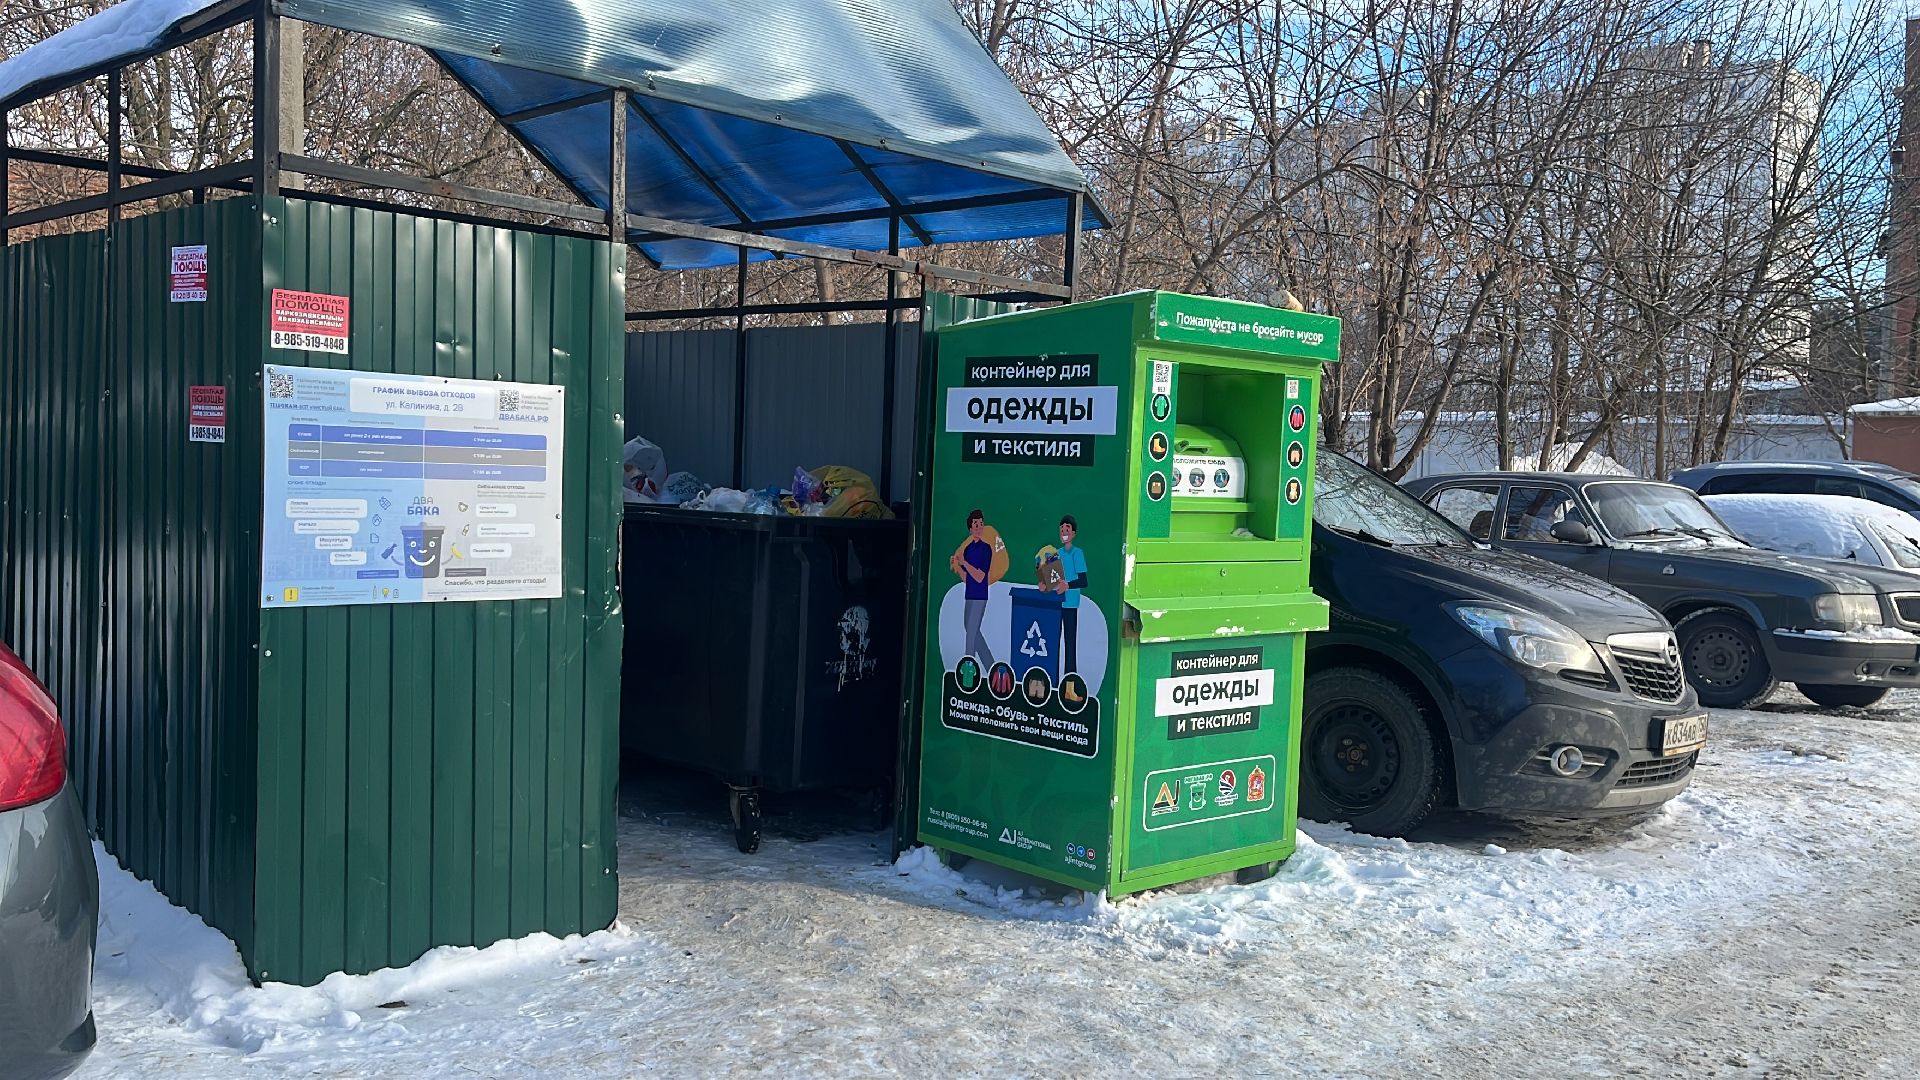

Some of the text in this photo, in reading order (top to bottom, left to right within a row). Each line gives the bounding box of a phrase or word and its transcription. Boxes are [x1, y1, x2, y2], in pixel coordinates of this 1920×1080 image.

[275, 300, 344, 314] ПОМОЩЬ
[276, 292, 344, 305] БЕСПЛАТНАЯ
[1176, 312, 1324, 344] Пожалуйста не бросайте мусор
[274, 332, 344, 350] 8-985-519-4848
[971, 362, 1091, 382] контейнер для
[372, 386, 476, 399] ГРАФИК ВЫВОЗА ОТХОДОВ
[385, 401, 397, 410] ул.
[399, 401, 442, 412] Калинина,
[967, 397, 1093, 424] одежды
[498, 414, 548, 422] ДВАБАКА.РФ
[974, 440, 1081, 457] и текстиля
[412, 496, 434, 506] ДВА
[408, 506, 440, 516] БАКА
[1176, 654, 1258, 669] контейнер для
[1172, 679, 1260, 706] одежды
[950, 709, 1088, 746] Можете положить свои вещи сюда
[996, 706, 1028, 722] Обувь
[1038, 714, 1088, 734] Текстиль
[1176, 712, 1252, 732] и текстиля
